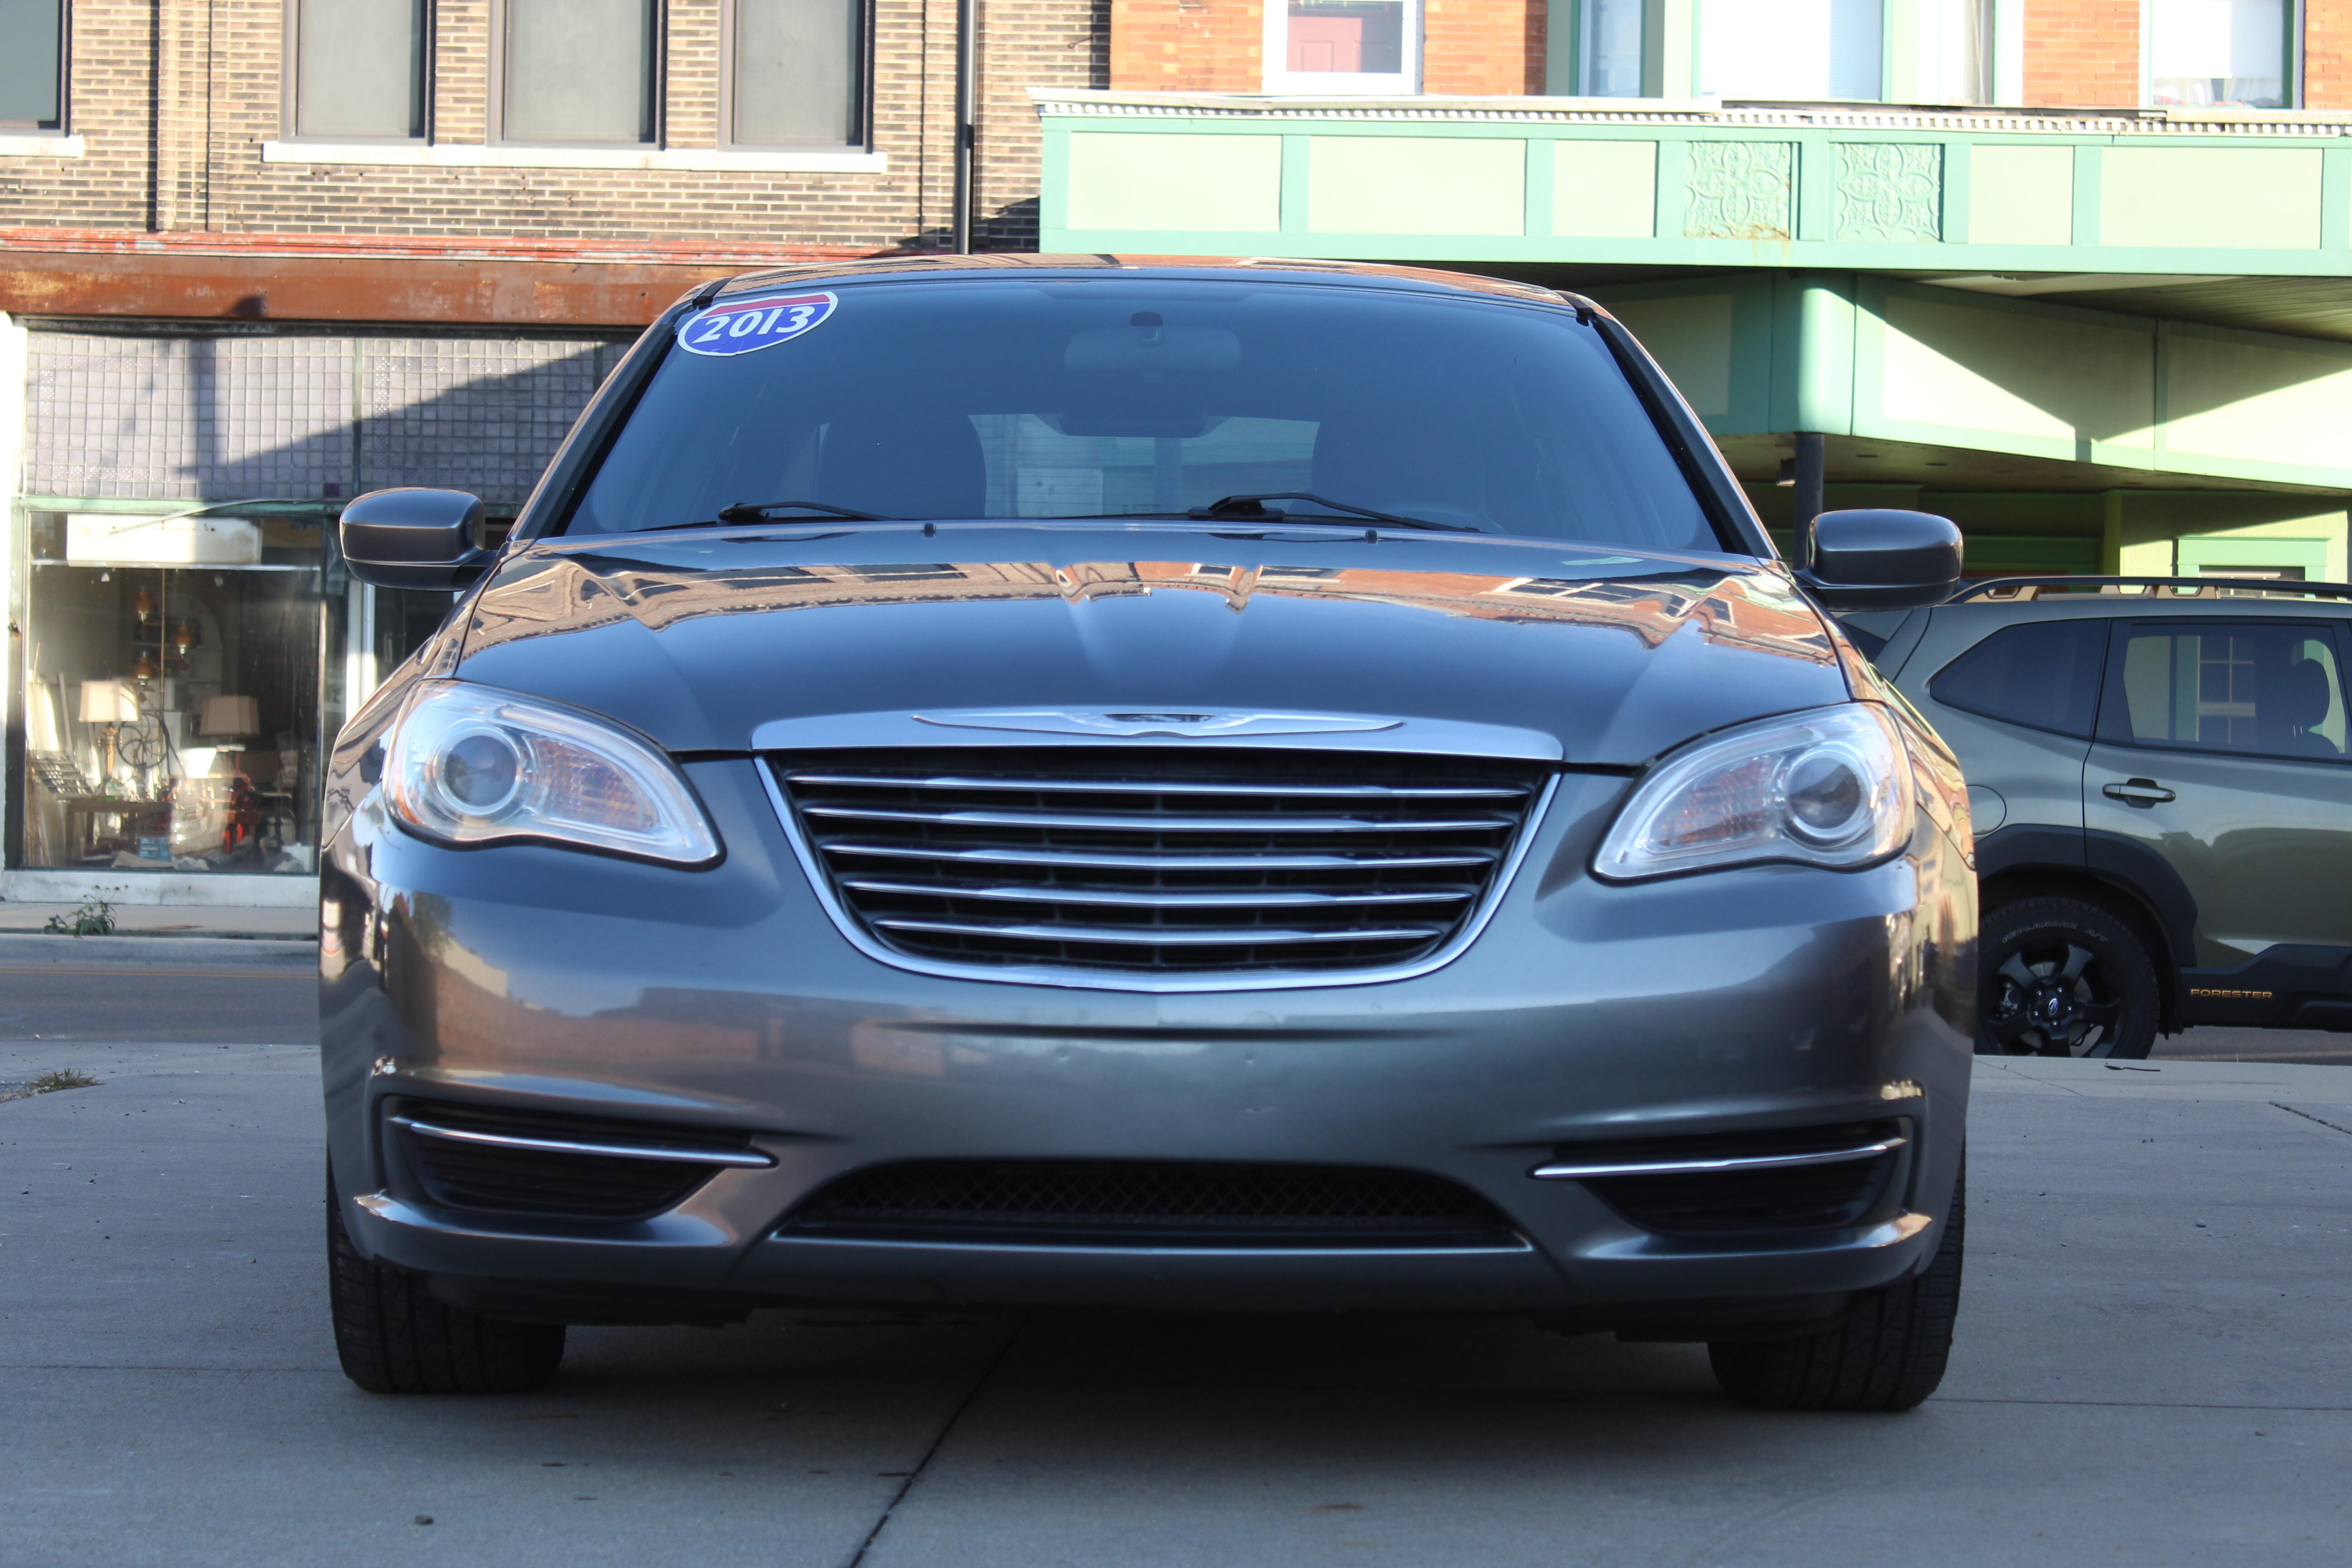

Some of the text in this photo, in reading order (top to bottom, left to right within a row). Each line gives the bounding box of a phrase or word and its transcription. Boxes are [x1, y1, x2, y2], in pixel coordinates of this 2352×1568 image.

[691, 305, 815, 344] 2013
[2002, 921, 2109, 944] GEOLANDAR A/T
[2190, 988, 2273, 999] FORESTER
